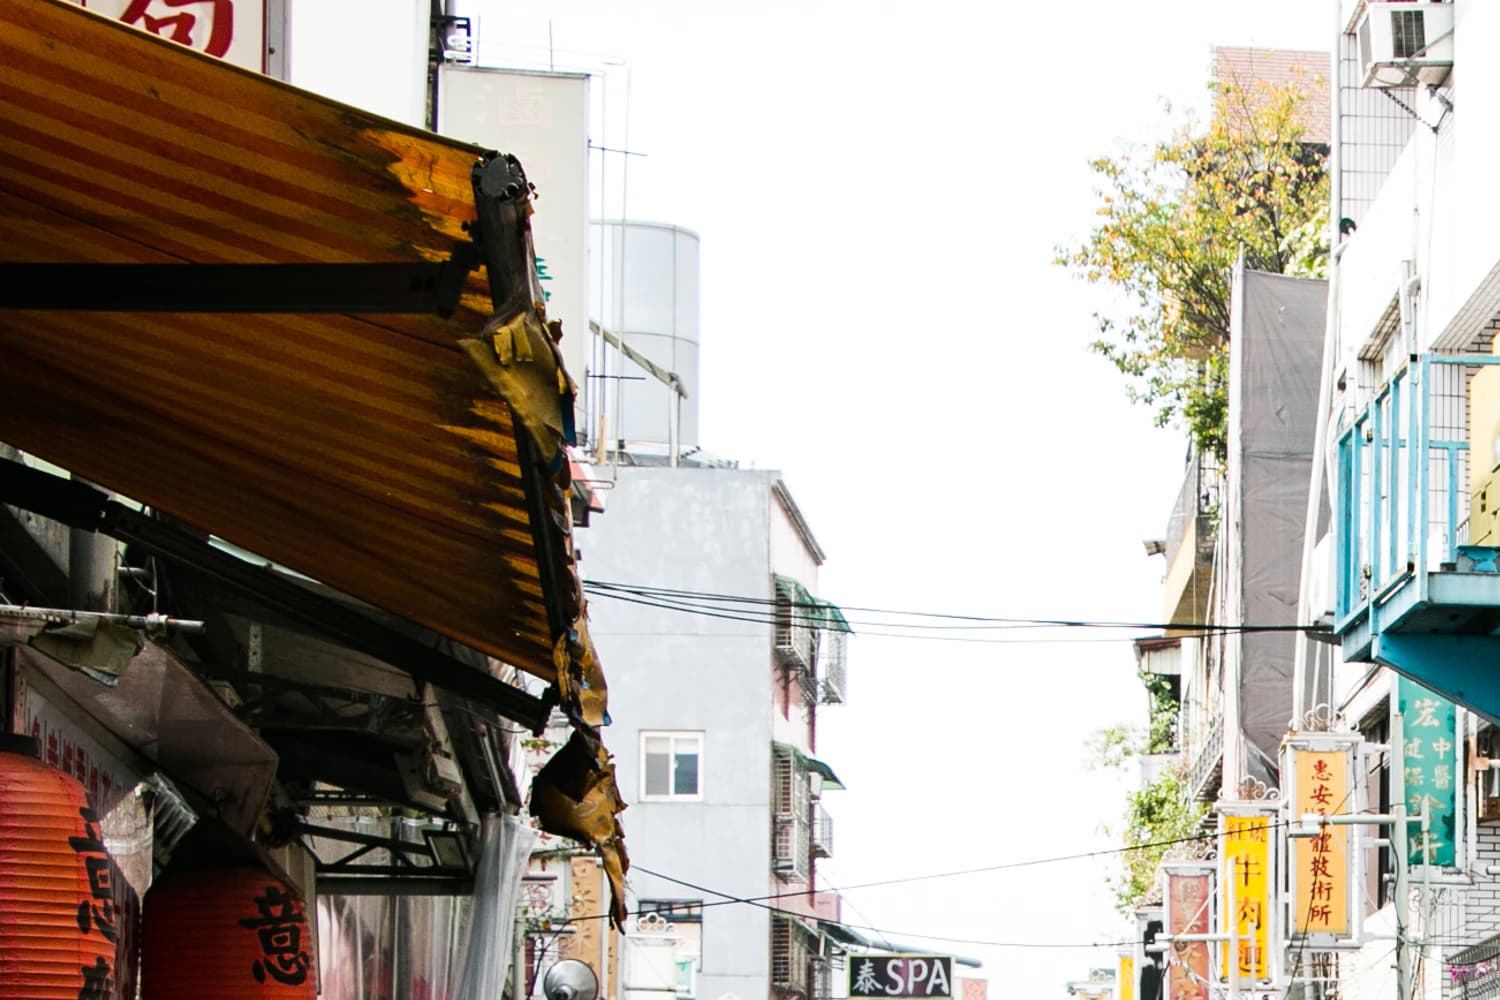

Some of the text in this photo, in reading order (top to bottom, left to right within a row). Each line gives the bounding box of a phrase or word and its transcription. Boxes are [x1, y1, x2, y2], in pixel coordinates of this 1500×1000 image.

[1309, 758, 1334, 926] 惠安體技術所
